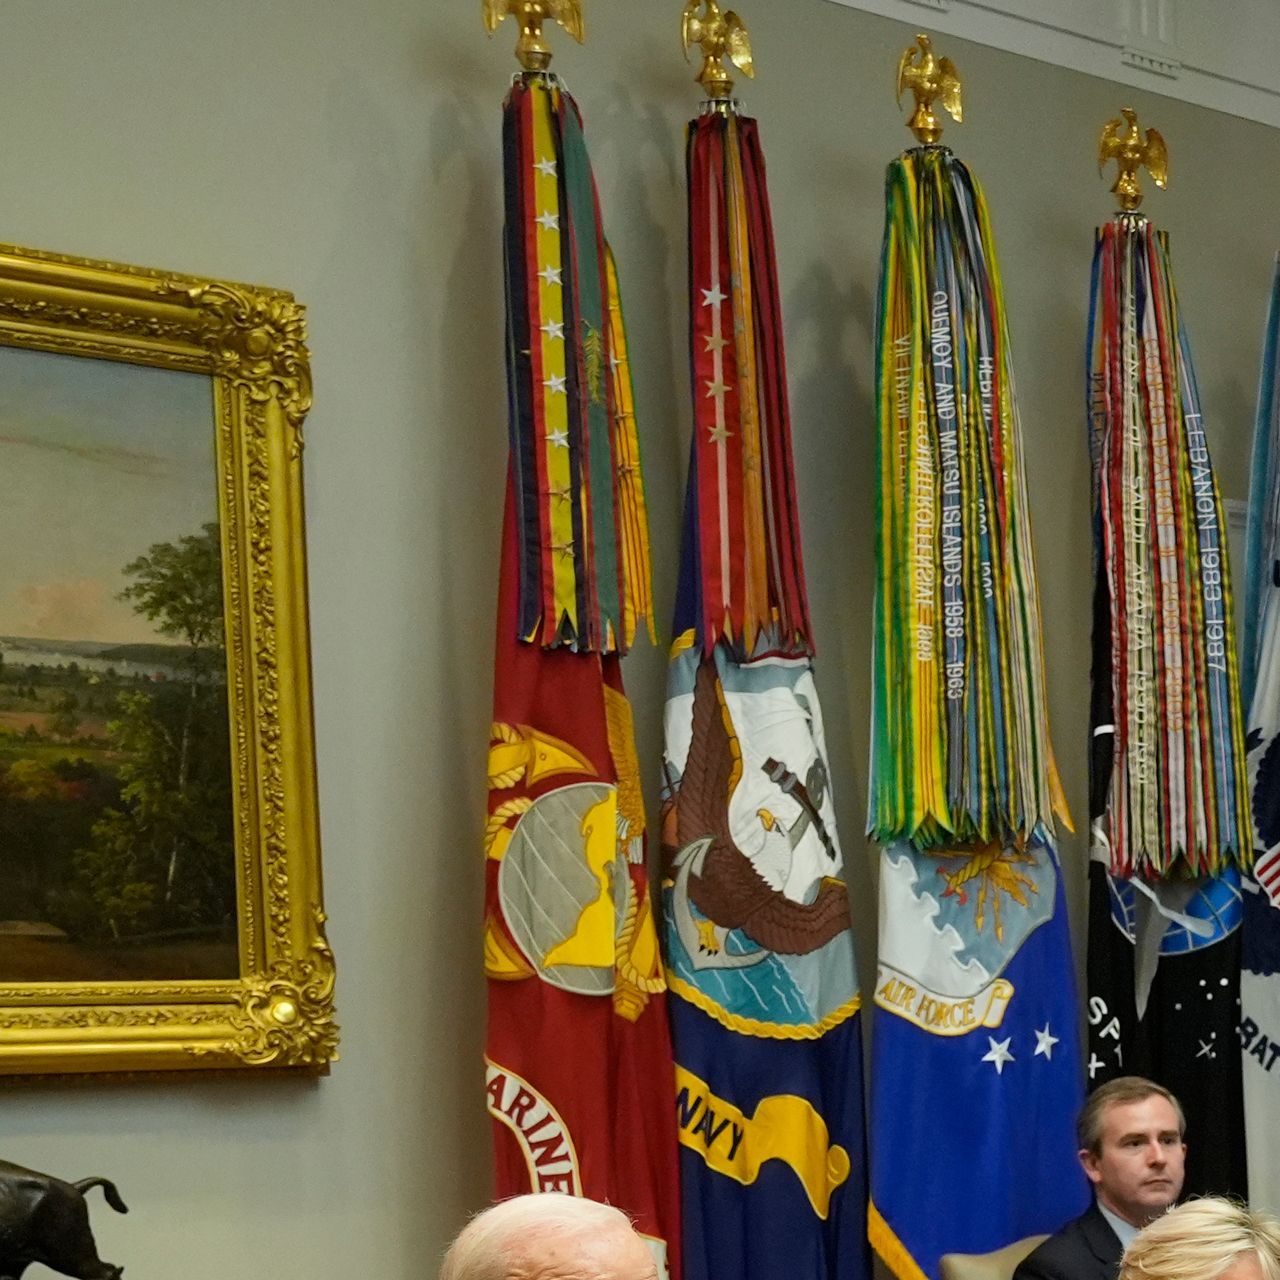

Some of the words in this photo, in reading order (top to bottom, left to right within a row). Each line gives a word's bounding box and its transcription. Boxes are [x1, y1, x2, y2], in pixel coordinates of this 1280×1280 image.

[934, 383, 955, 420] AND
[940, 430, 960, 494] MATSU
[1185, 412, 1217, 530] LEBANON
[942, 505, 962, 587] ISLANDS
[945, 600, 964, 638] 1958
[879, 977, 917, 1012] AIR
[915, 994, 977, 1028] FORCE
[676, 1086, 744, 1161] NAVY
